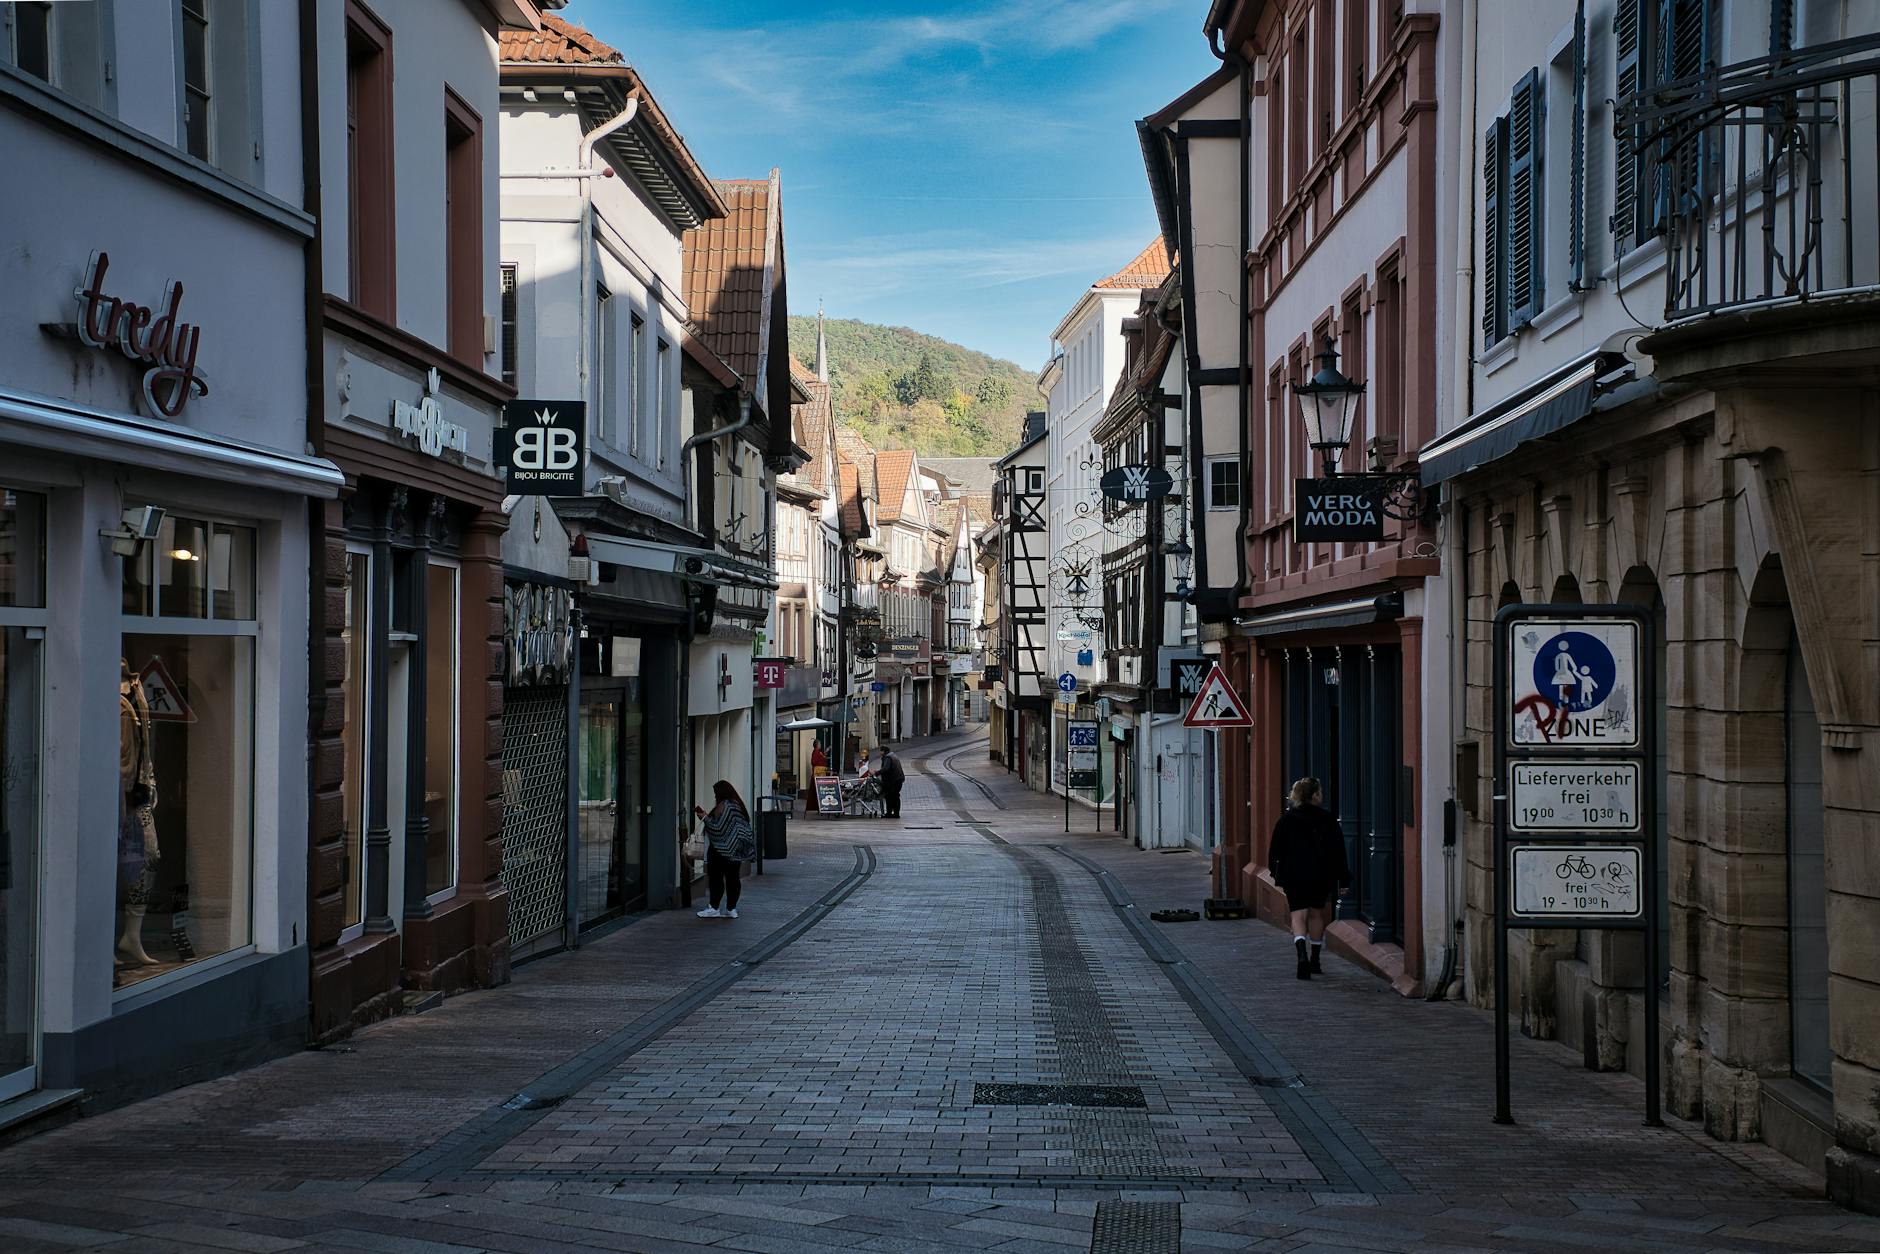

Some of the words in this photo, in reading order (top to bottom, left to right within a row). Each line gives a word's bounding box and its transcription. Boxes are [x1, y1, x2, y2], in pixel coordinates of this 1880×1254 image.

[74, 250, 208, 418] tredy
[512, 427, 578, 470] BB
[514, 471, 538, 481] BIJOU
[539, 472, 575, 481] BRIGITTE
[1123, 467, 1151, 499] WMF
[1304, 511, 1377, 526] MODA
[1546, 718, 1606, 737] ZONE
[1517, 770, 1632, 786] Lieferverkehr
[1561, 789, 1590, 804] frei
[1619, 810, 1629, 823] h
[1565, 882, 1587, 893] frei
[1542, 896, 1555, 909] 19
[1601, 897, 1609, 909] h
